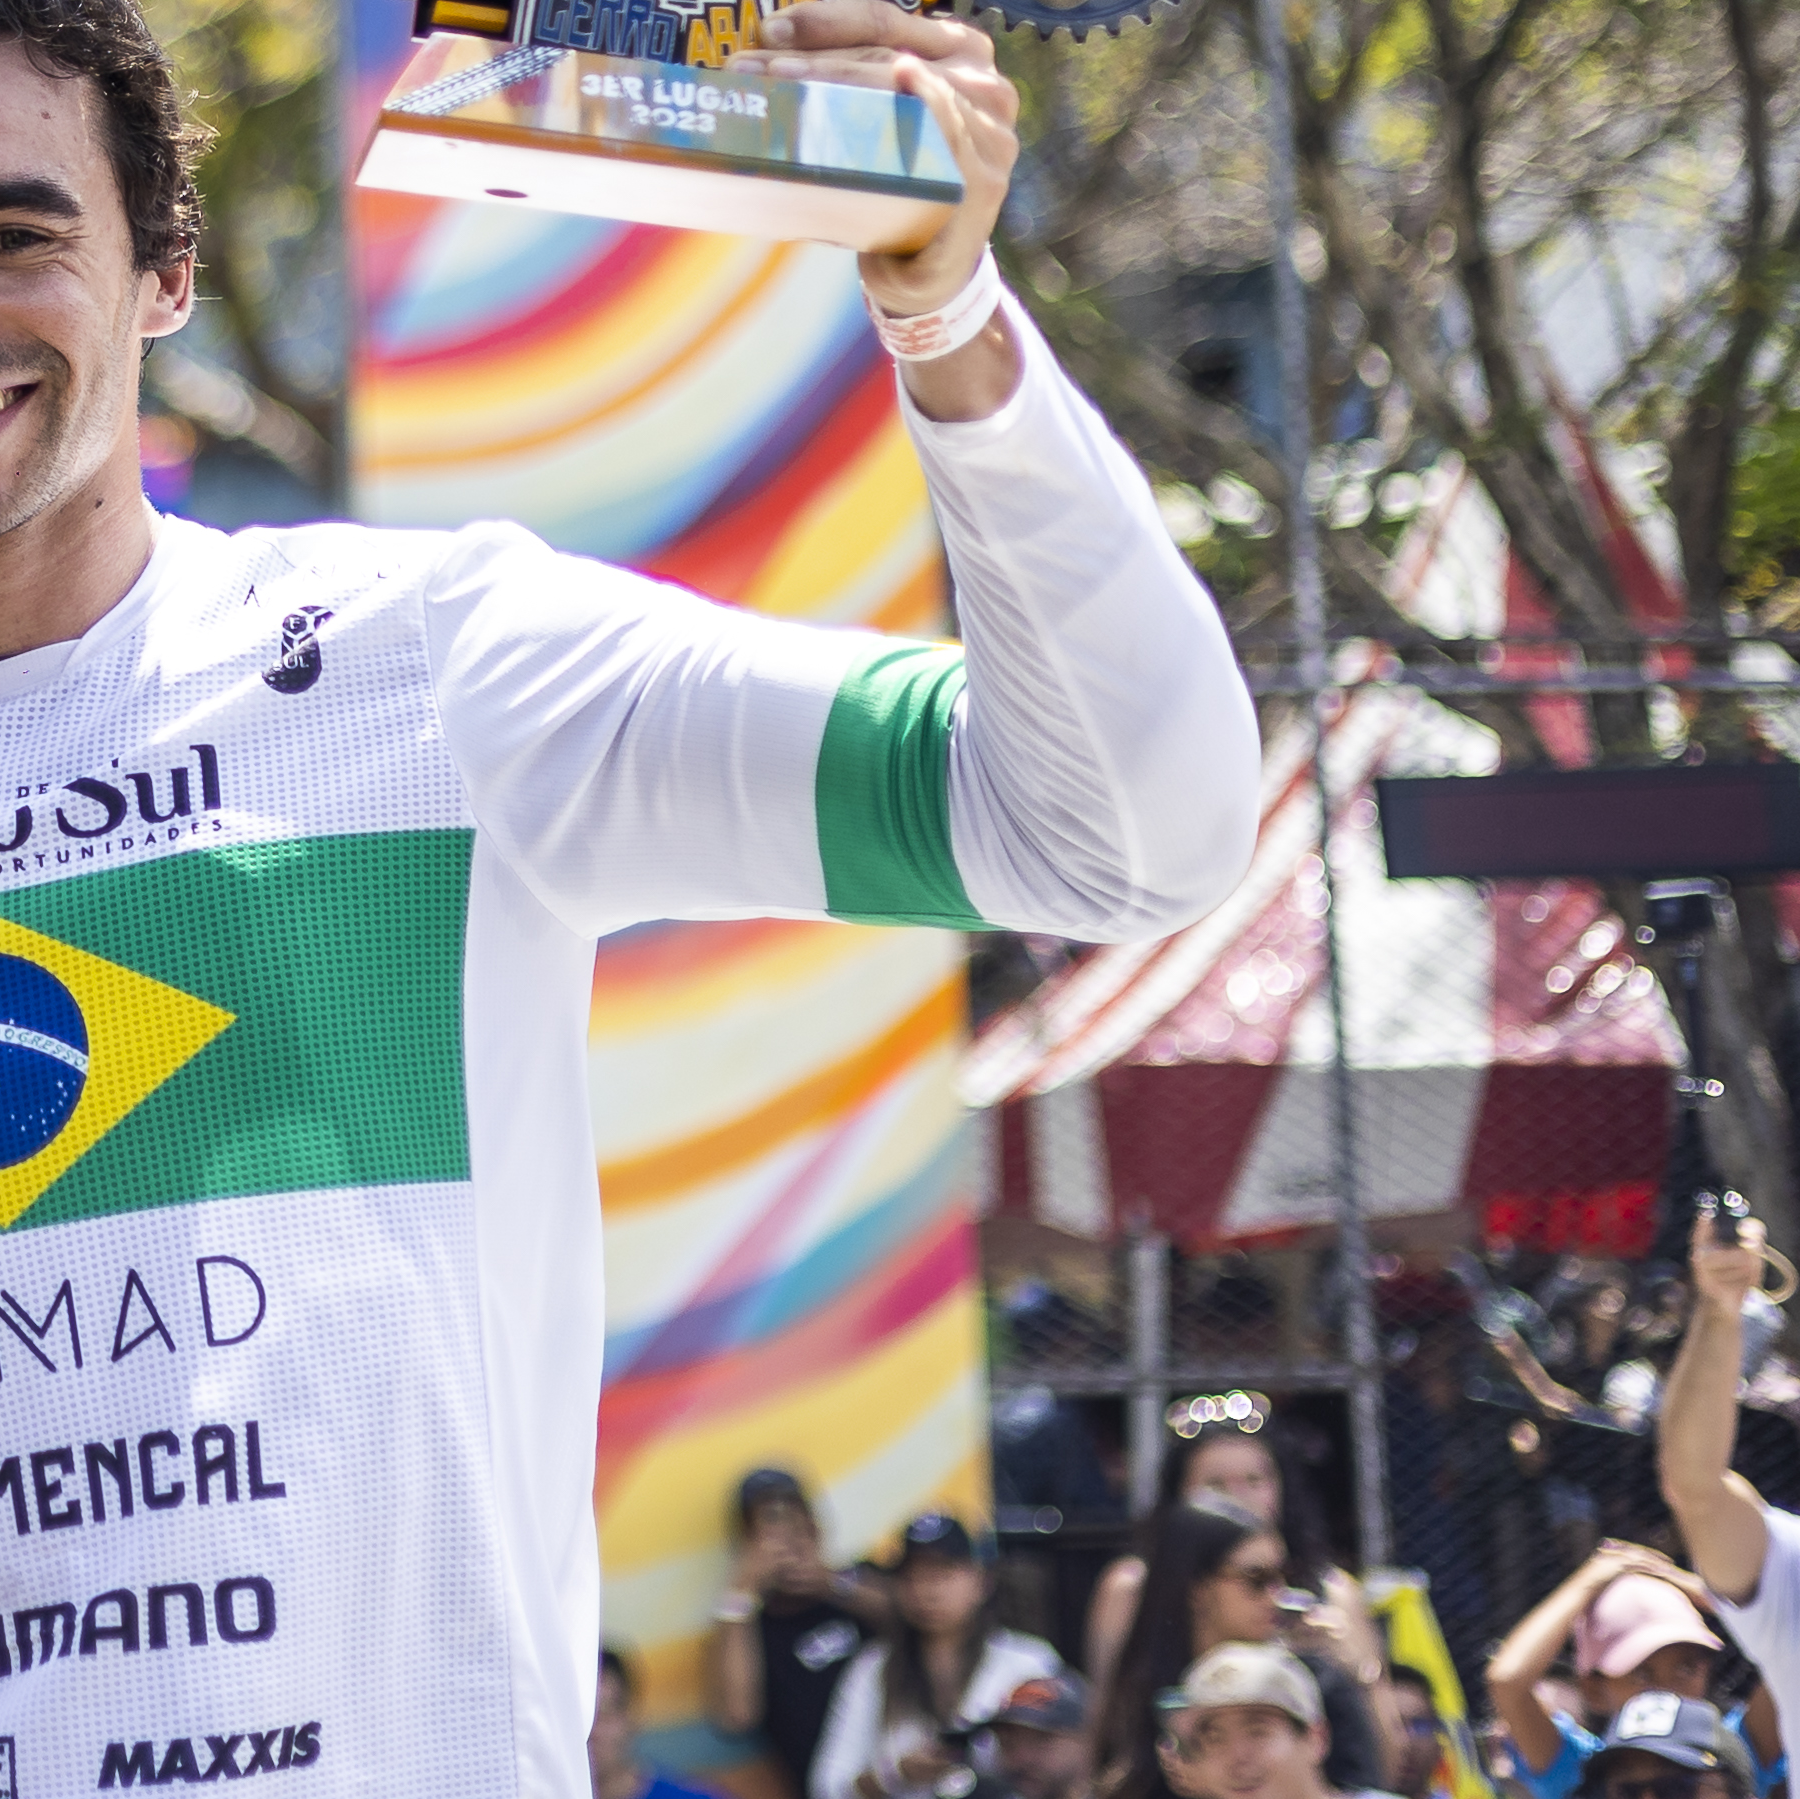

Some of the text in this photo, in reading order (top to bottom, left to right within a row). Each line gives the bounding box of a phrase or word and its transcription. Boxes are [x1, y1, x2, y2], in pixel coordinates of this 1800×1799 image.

[579, 74, 769, 119] 3ER LUGAR
[629, 103, 718, 133] 2023
[17, 783, 49, 799] DE
[56, 743, 222, 840] Sul
[98, 1720, 323, 1789] MAXXIS
